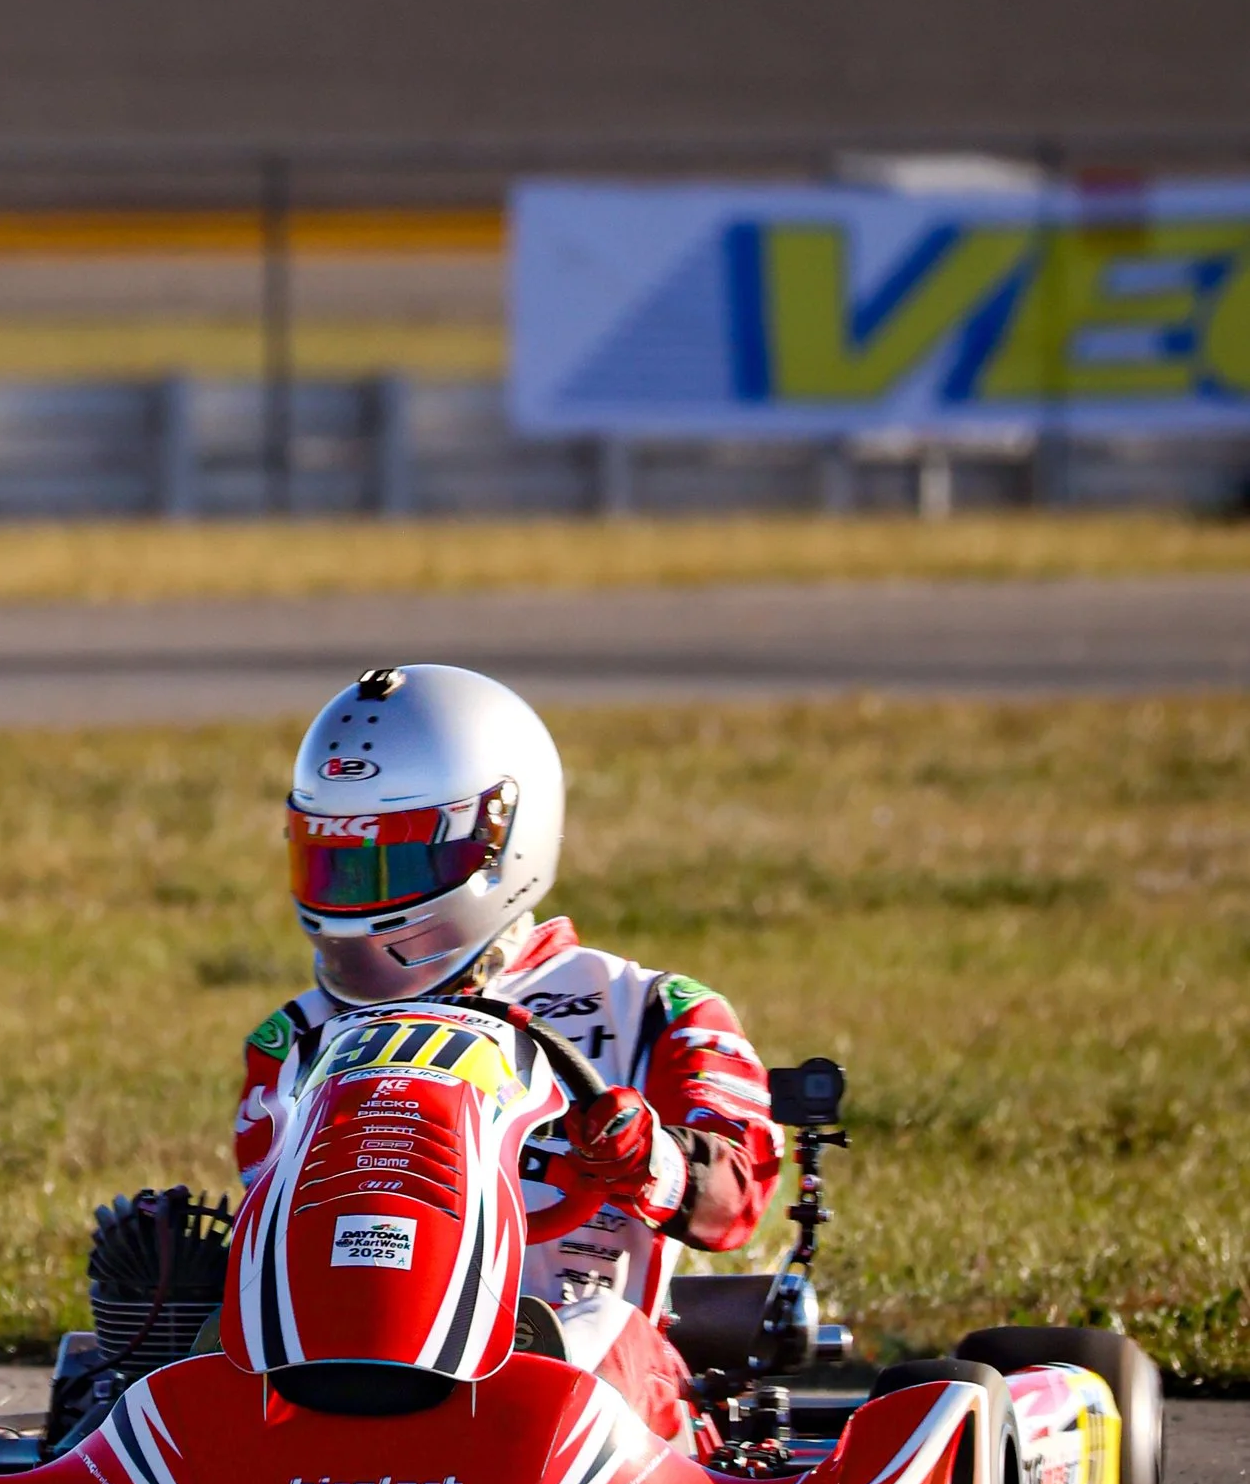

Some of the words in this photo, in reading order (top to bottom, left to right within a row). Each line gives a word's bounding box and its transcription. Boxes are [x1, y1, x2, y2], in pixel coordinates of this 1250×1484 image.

[303, 816, 380, 839] TKG
[327, 1022, 480, 1076] 911
[346, 1067, 454, 1082] FREELINE
[360, 1100, 419, 1108] JECKO
[341, 1231, 409, 1241] DAYTONA
[354, 1239, 411, 1250] KartWeek
[348, 1248, 395, 1259] 2025
